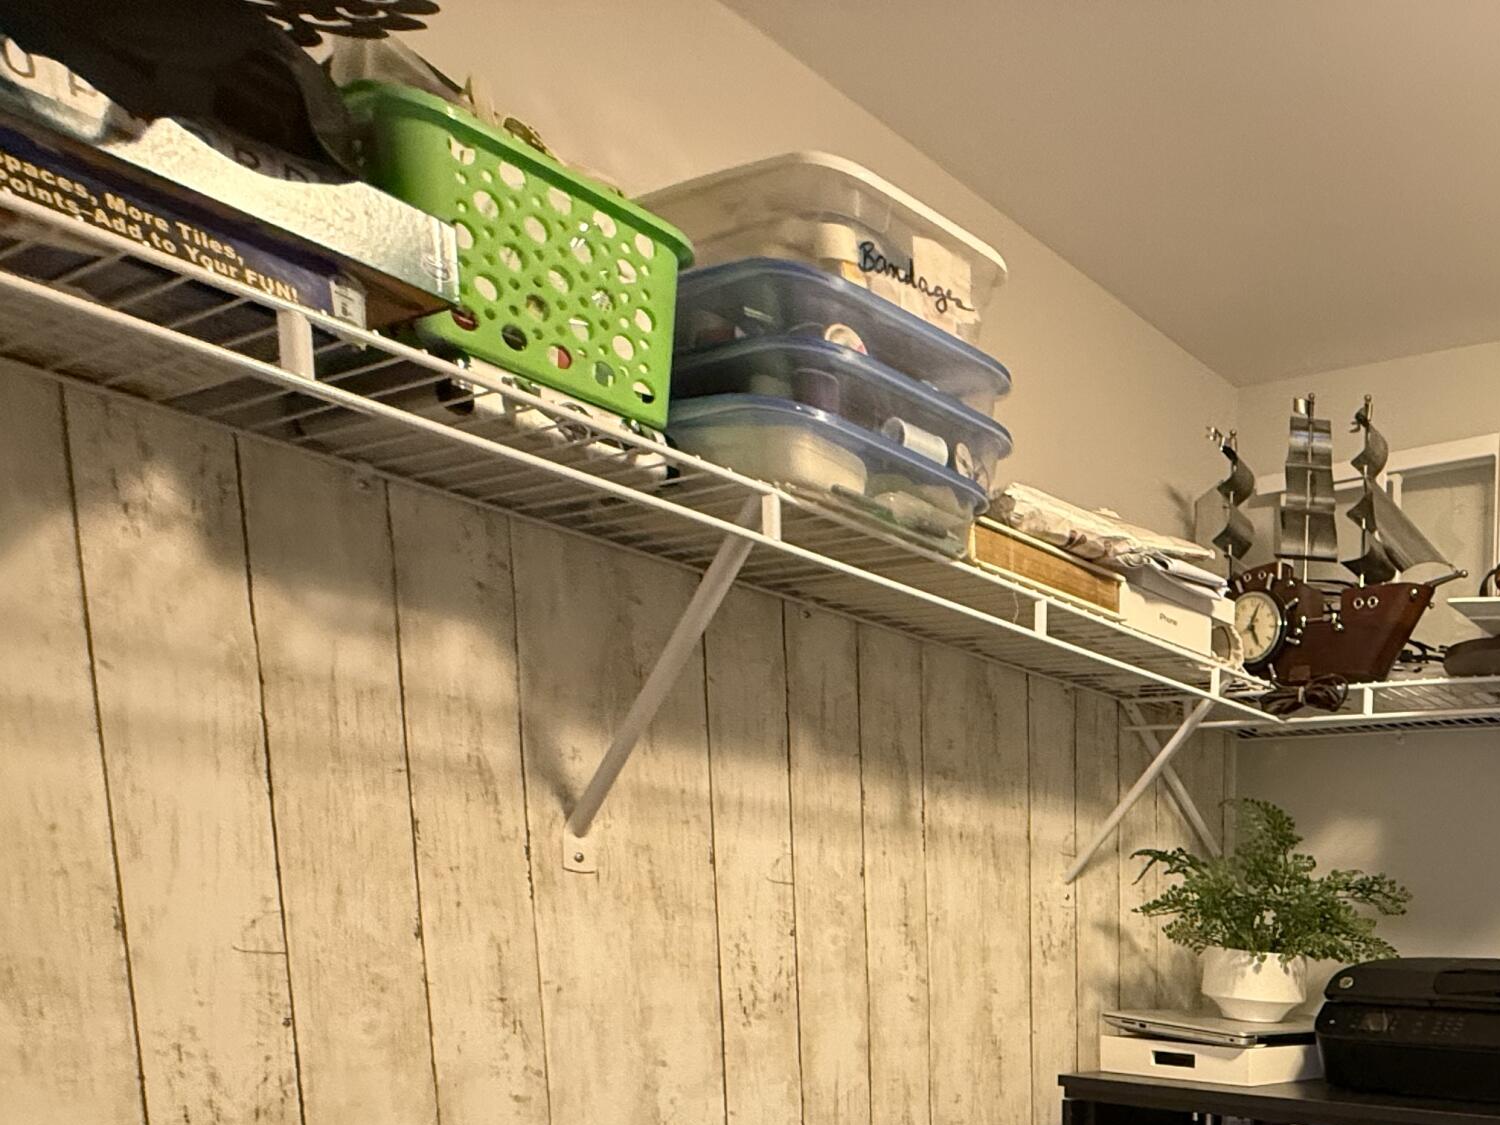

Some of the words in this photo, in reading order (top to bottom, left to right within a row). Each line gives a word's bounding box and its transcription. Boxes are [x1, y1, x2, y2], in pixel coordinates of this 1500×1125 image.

[0, 152, 98, 207] paces,
[105, 192, 169, 233] More
[175, 221, 244, 267] Tiles,
[151, 231, 177, 254] to
[183, 243, 239, 279] Your
[245, 268, 299, 303] FUN!
